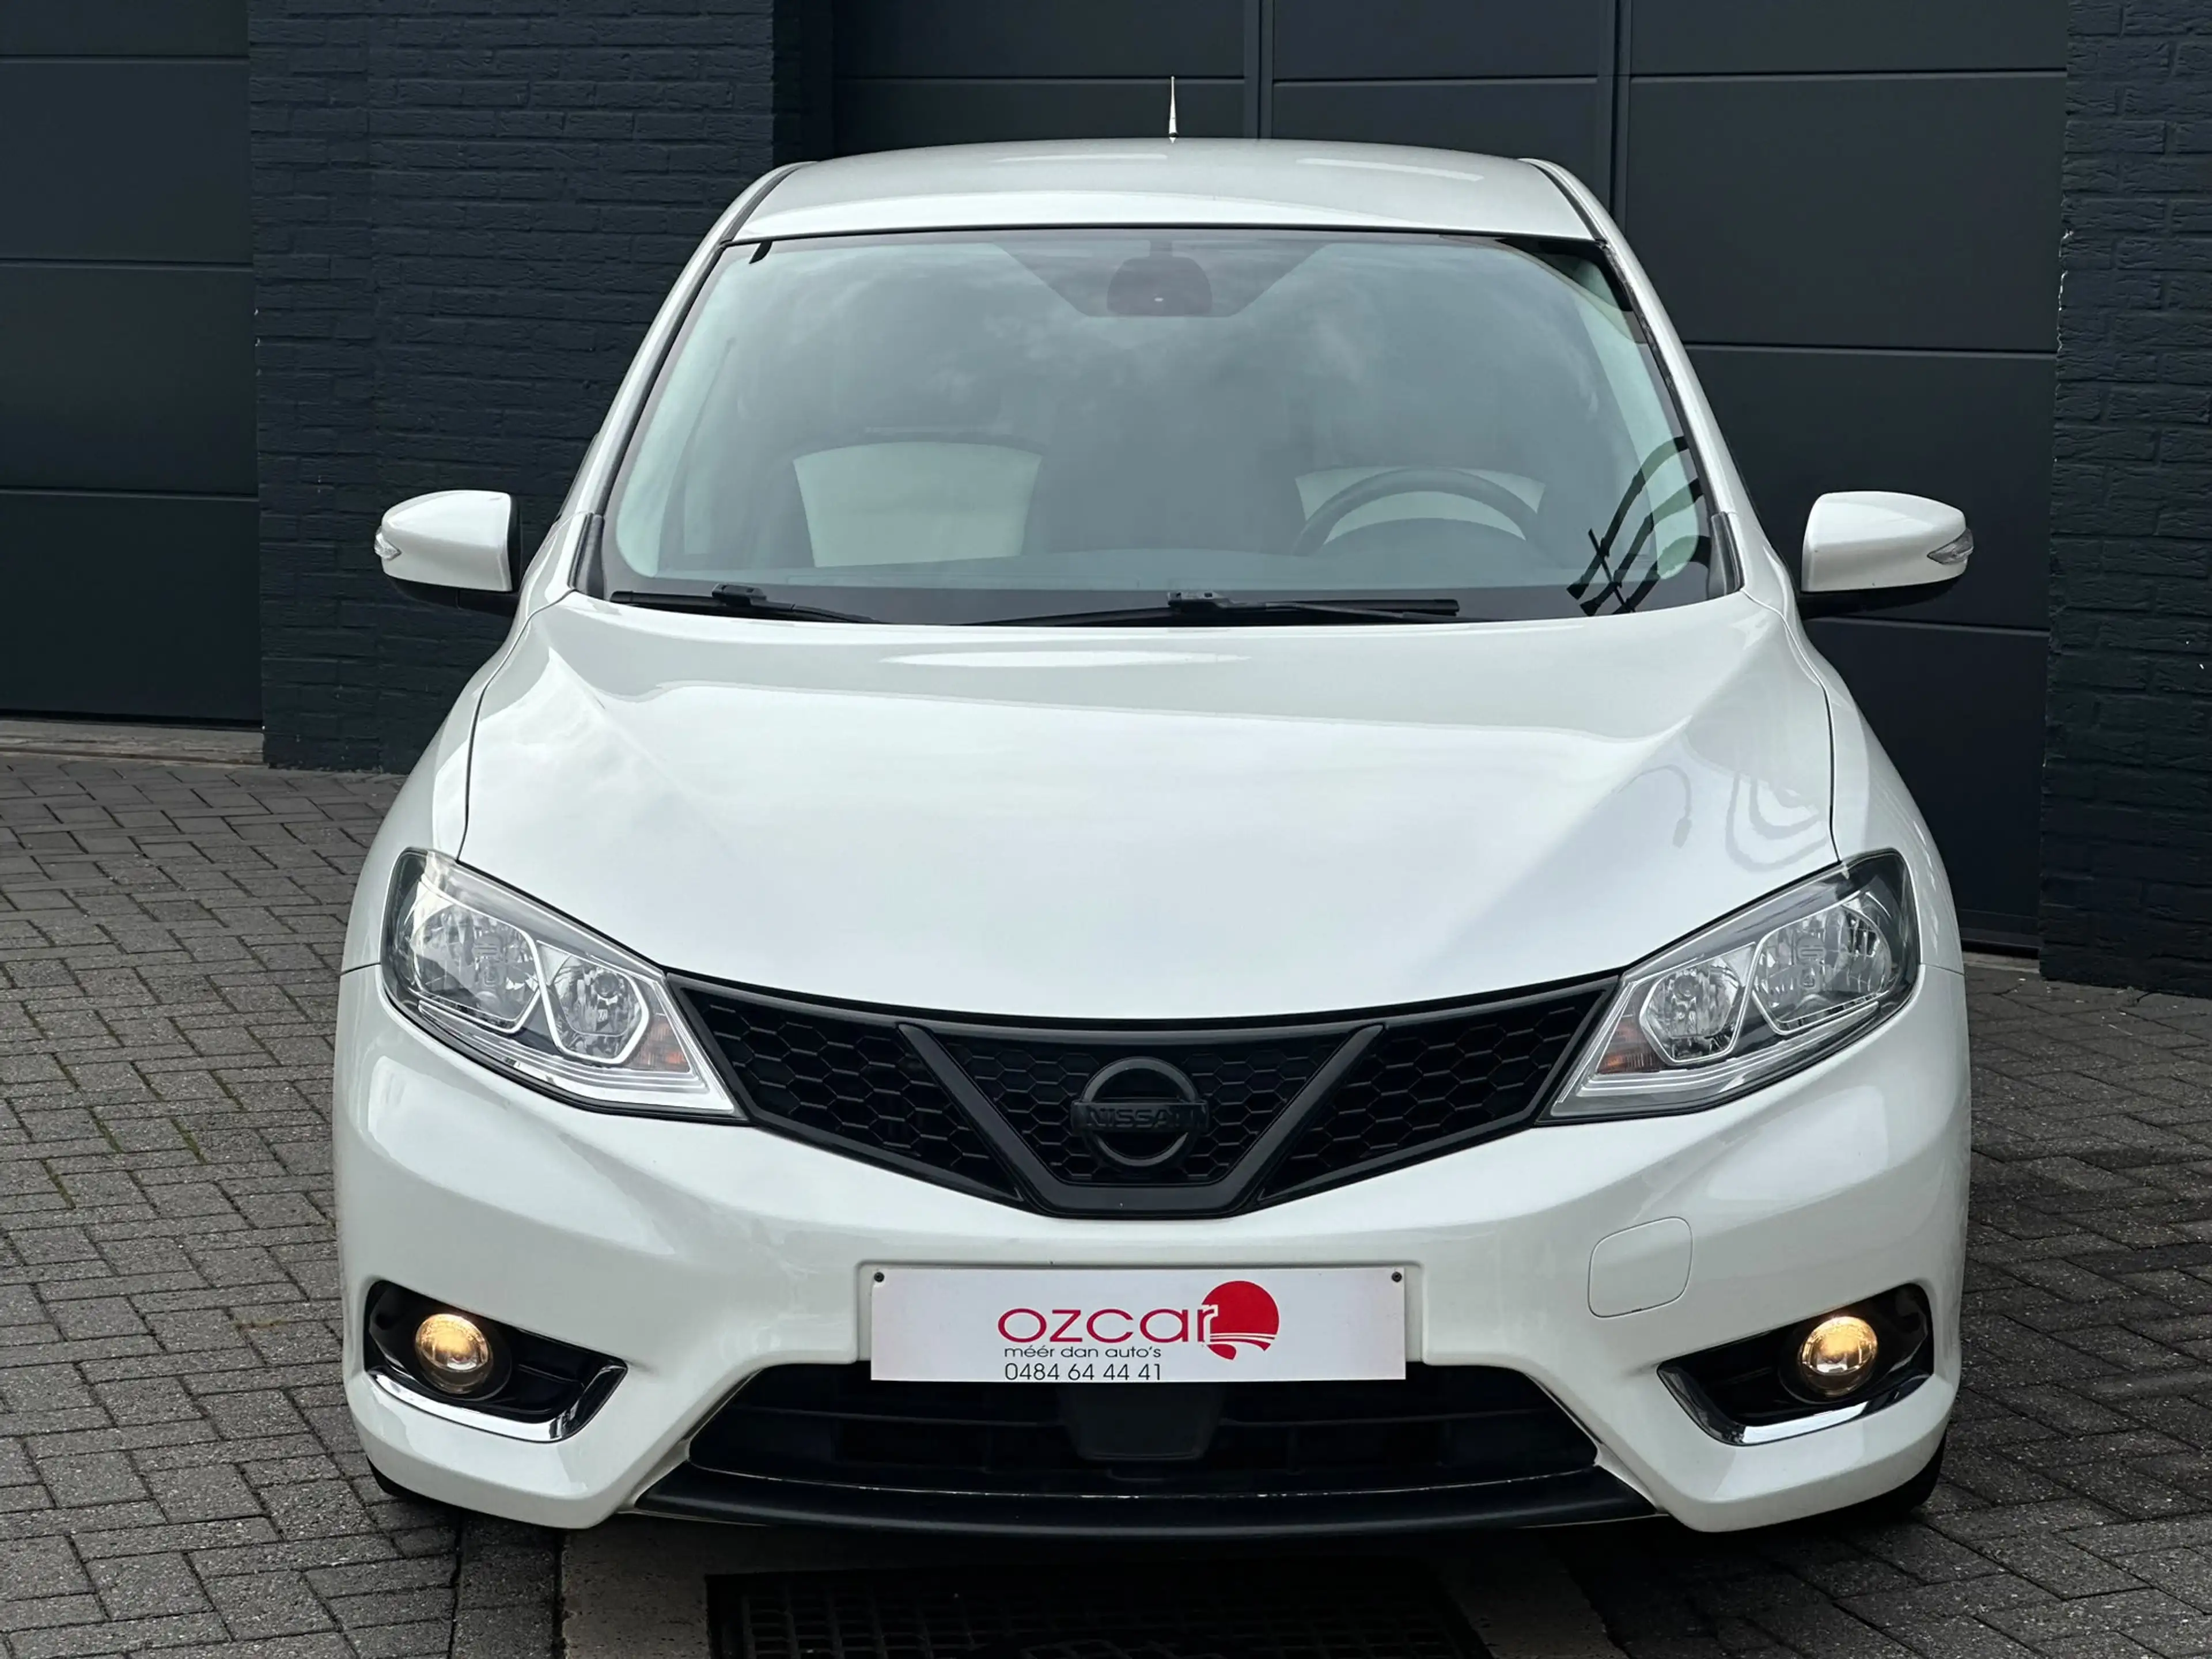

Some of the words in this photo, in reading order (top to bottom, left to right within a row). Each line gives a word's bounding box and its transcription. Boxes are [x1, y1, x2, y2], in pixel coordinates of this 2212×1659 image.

[998, 1308, 1215, 1343] ozcar
[1004, 1344, 1055, 1358] méér
[1060, 1346, 1099, 1358] dan
[1105, 1346, 1161, 1358] auto's
[1005, 1363, 1060, 1381] 0484
[1068, 1363, 1094, 1381] 64
[1103, 1363, 1130, 1381] 44
[1138, 1363, 1160, 1381] 41
